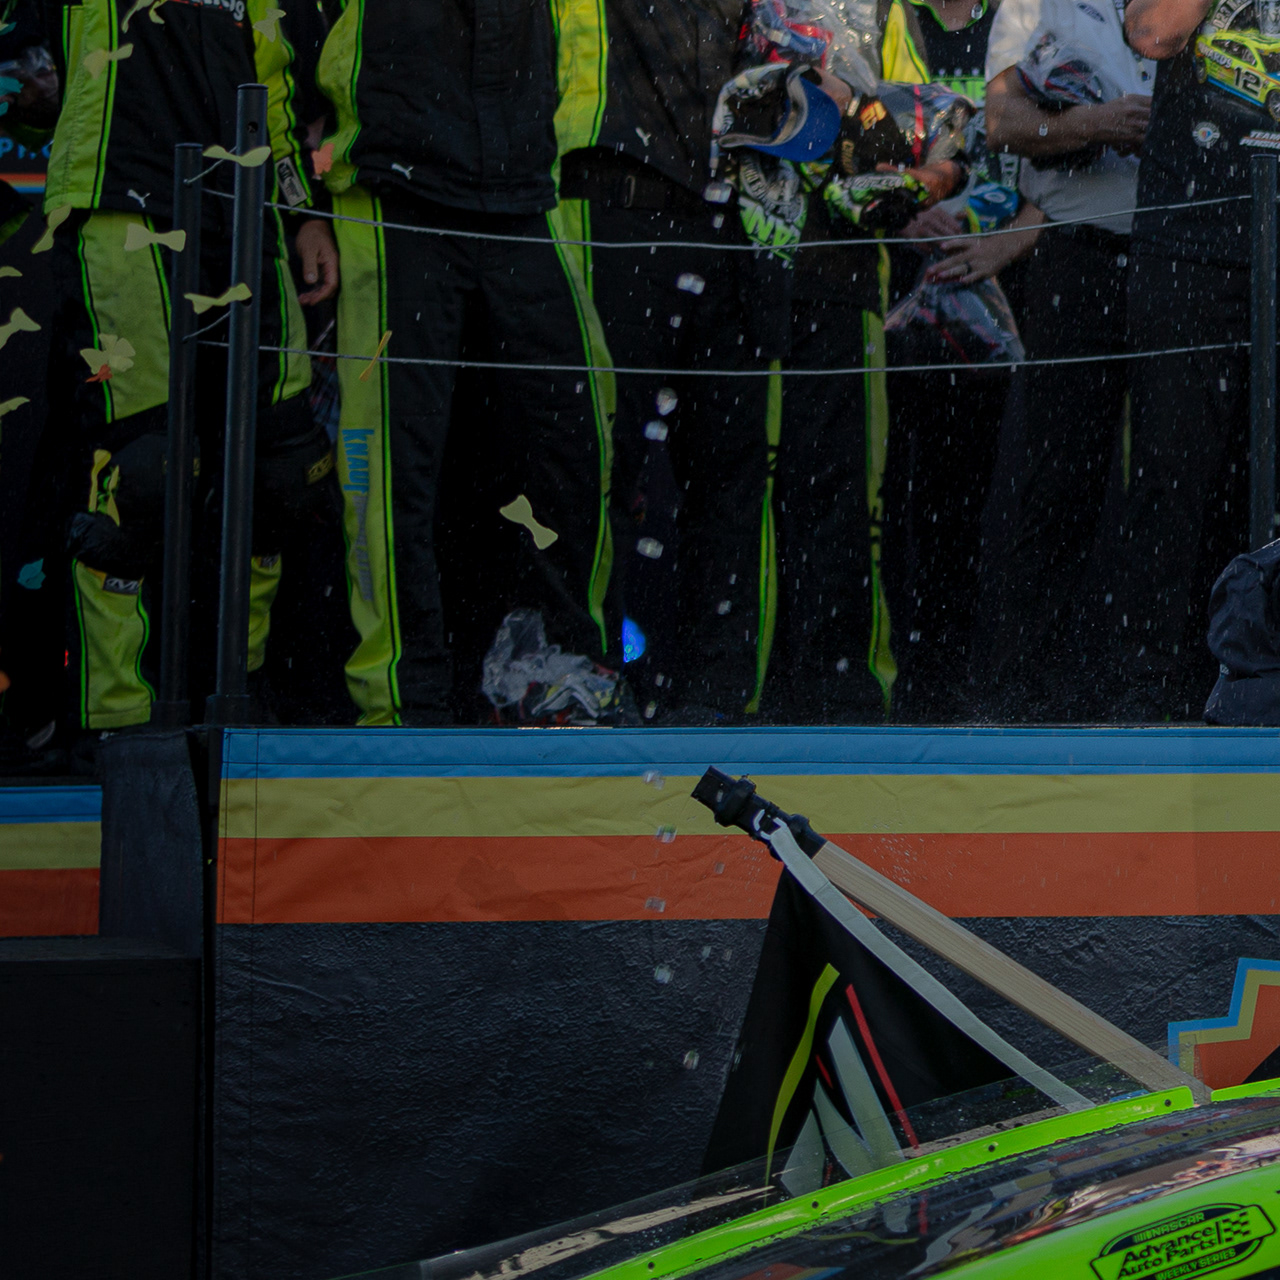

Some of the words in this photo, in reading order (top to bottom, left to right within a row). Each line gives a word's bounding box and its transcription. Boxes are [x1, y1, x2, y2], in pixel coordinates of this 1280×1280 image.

[1151, 1212, 1206, 1238] NASCAR
[1117, 1255, 1163, 1280] Auto
[1166, 1238, 1218, 1263] Parts
[1121, 1226, 1214, 1266] Advance
[1200, 1248, 1237, 1268] SERIES
